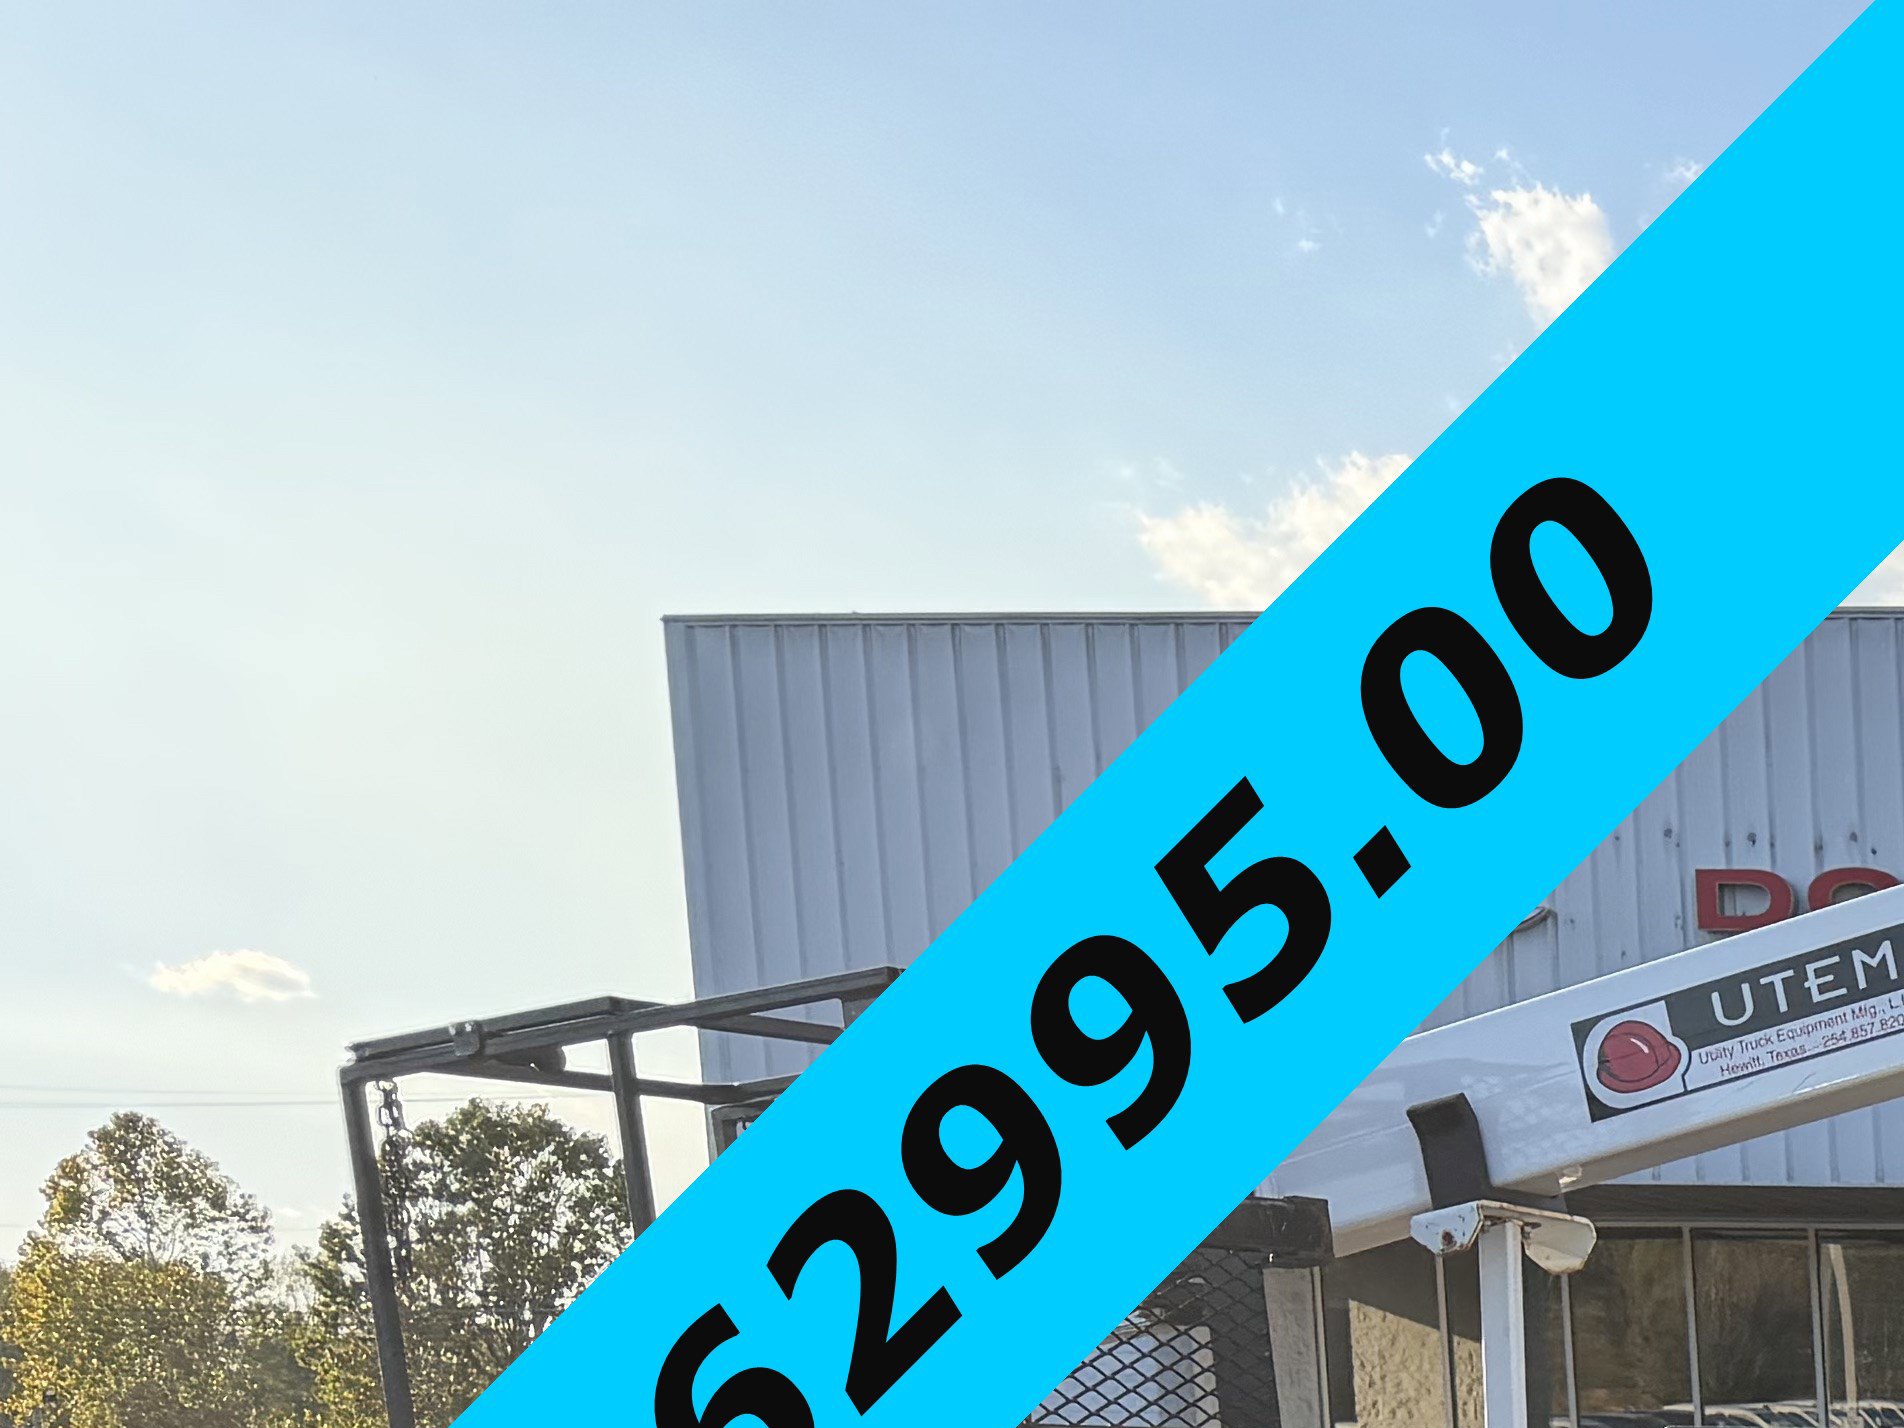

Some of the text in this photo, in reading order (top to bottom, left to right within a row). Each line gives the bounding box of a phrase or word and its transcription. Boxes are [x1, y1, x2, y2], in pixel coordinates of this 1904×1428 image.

[1711, 940, 1899, 1028] UTEM
[1738, 1033, 1774, 1054] Truck
[1775, 1012, 1849, 1042] Equipment
